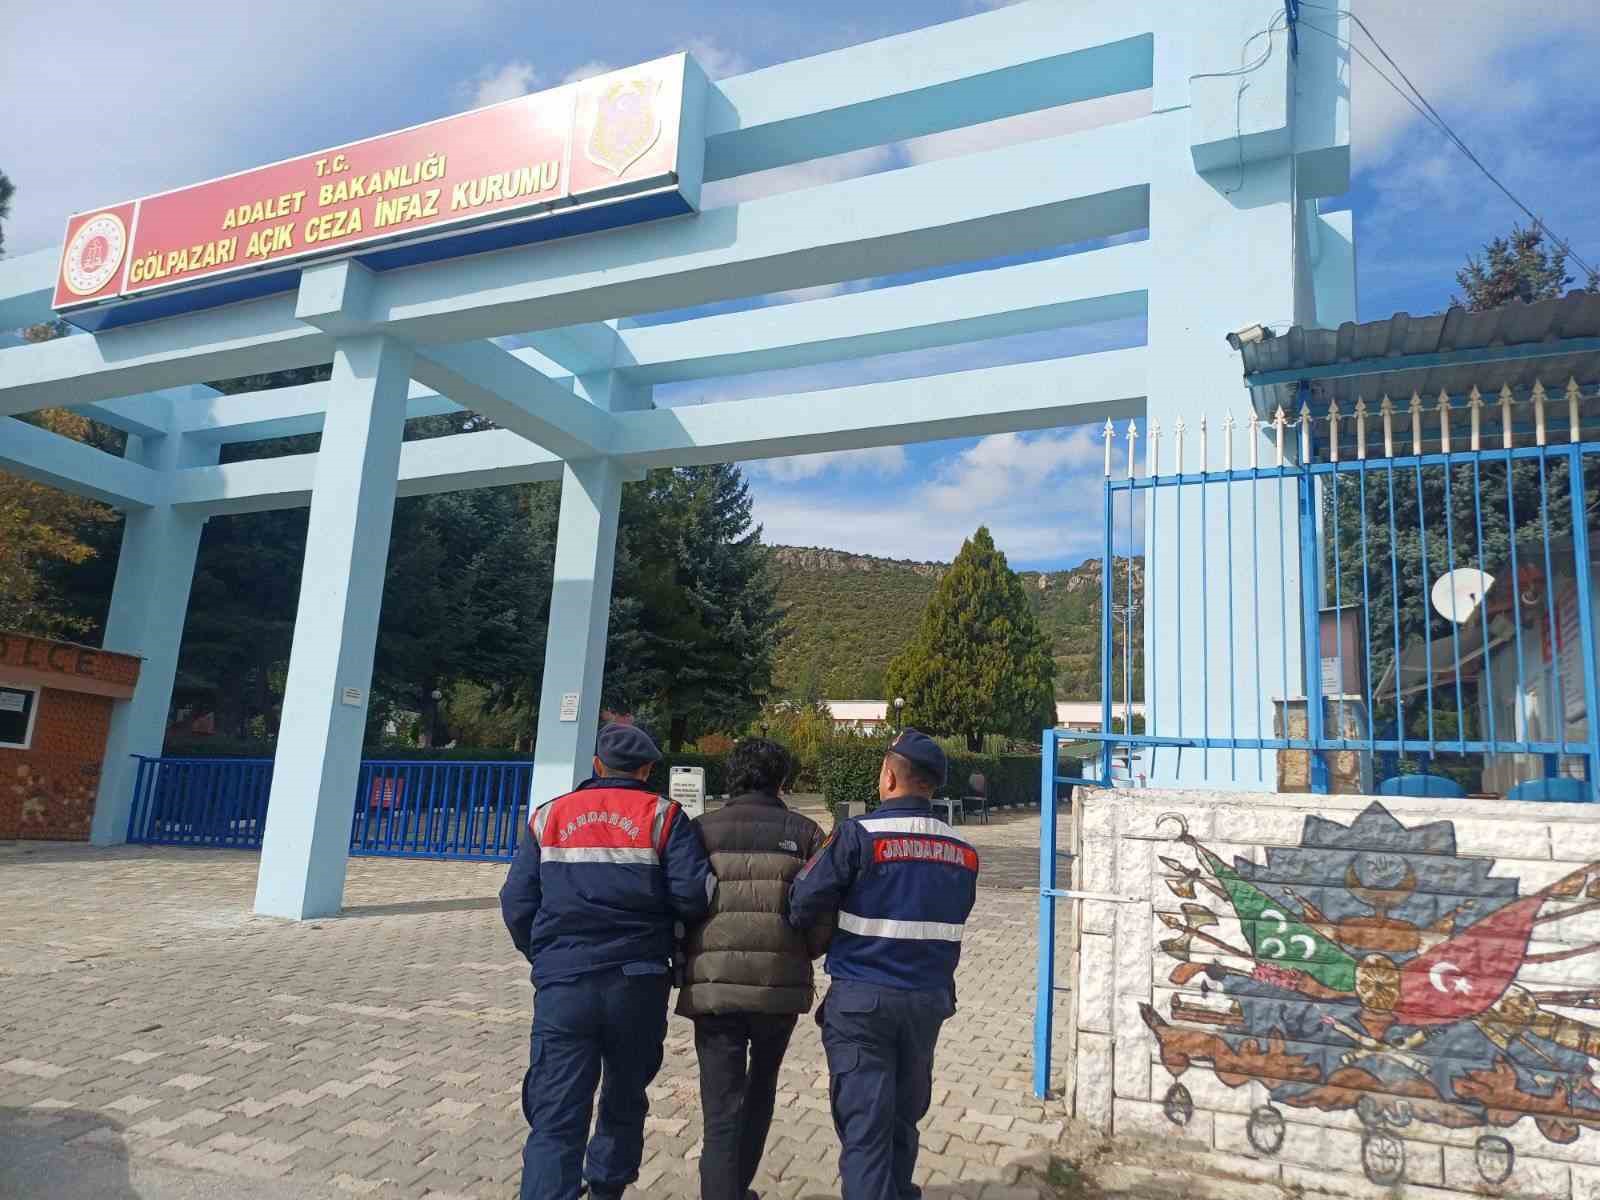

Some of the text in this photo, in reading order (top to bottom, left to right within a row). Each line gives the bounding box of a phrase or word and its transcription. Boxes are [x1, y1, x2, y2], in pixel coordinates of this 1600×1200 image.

[315, 157, 350, 179] T.C.
[222, 153, 447, 230] ADALET BAKANLIĞI
[129, 160, 559, 284] GÖLPAZARI AÇIK CEZA İNFAZ KURUMU
[559, 811, 640, 841] JANDARMA
[882, 839, 965, 865] JANDARMA
